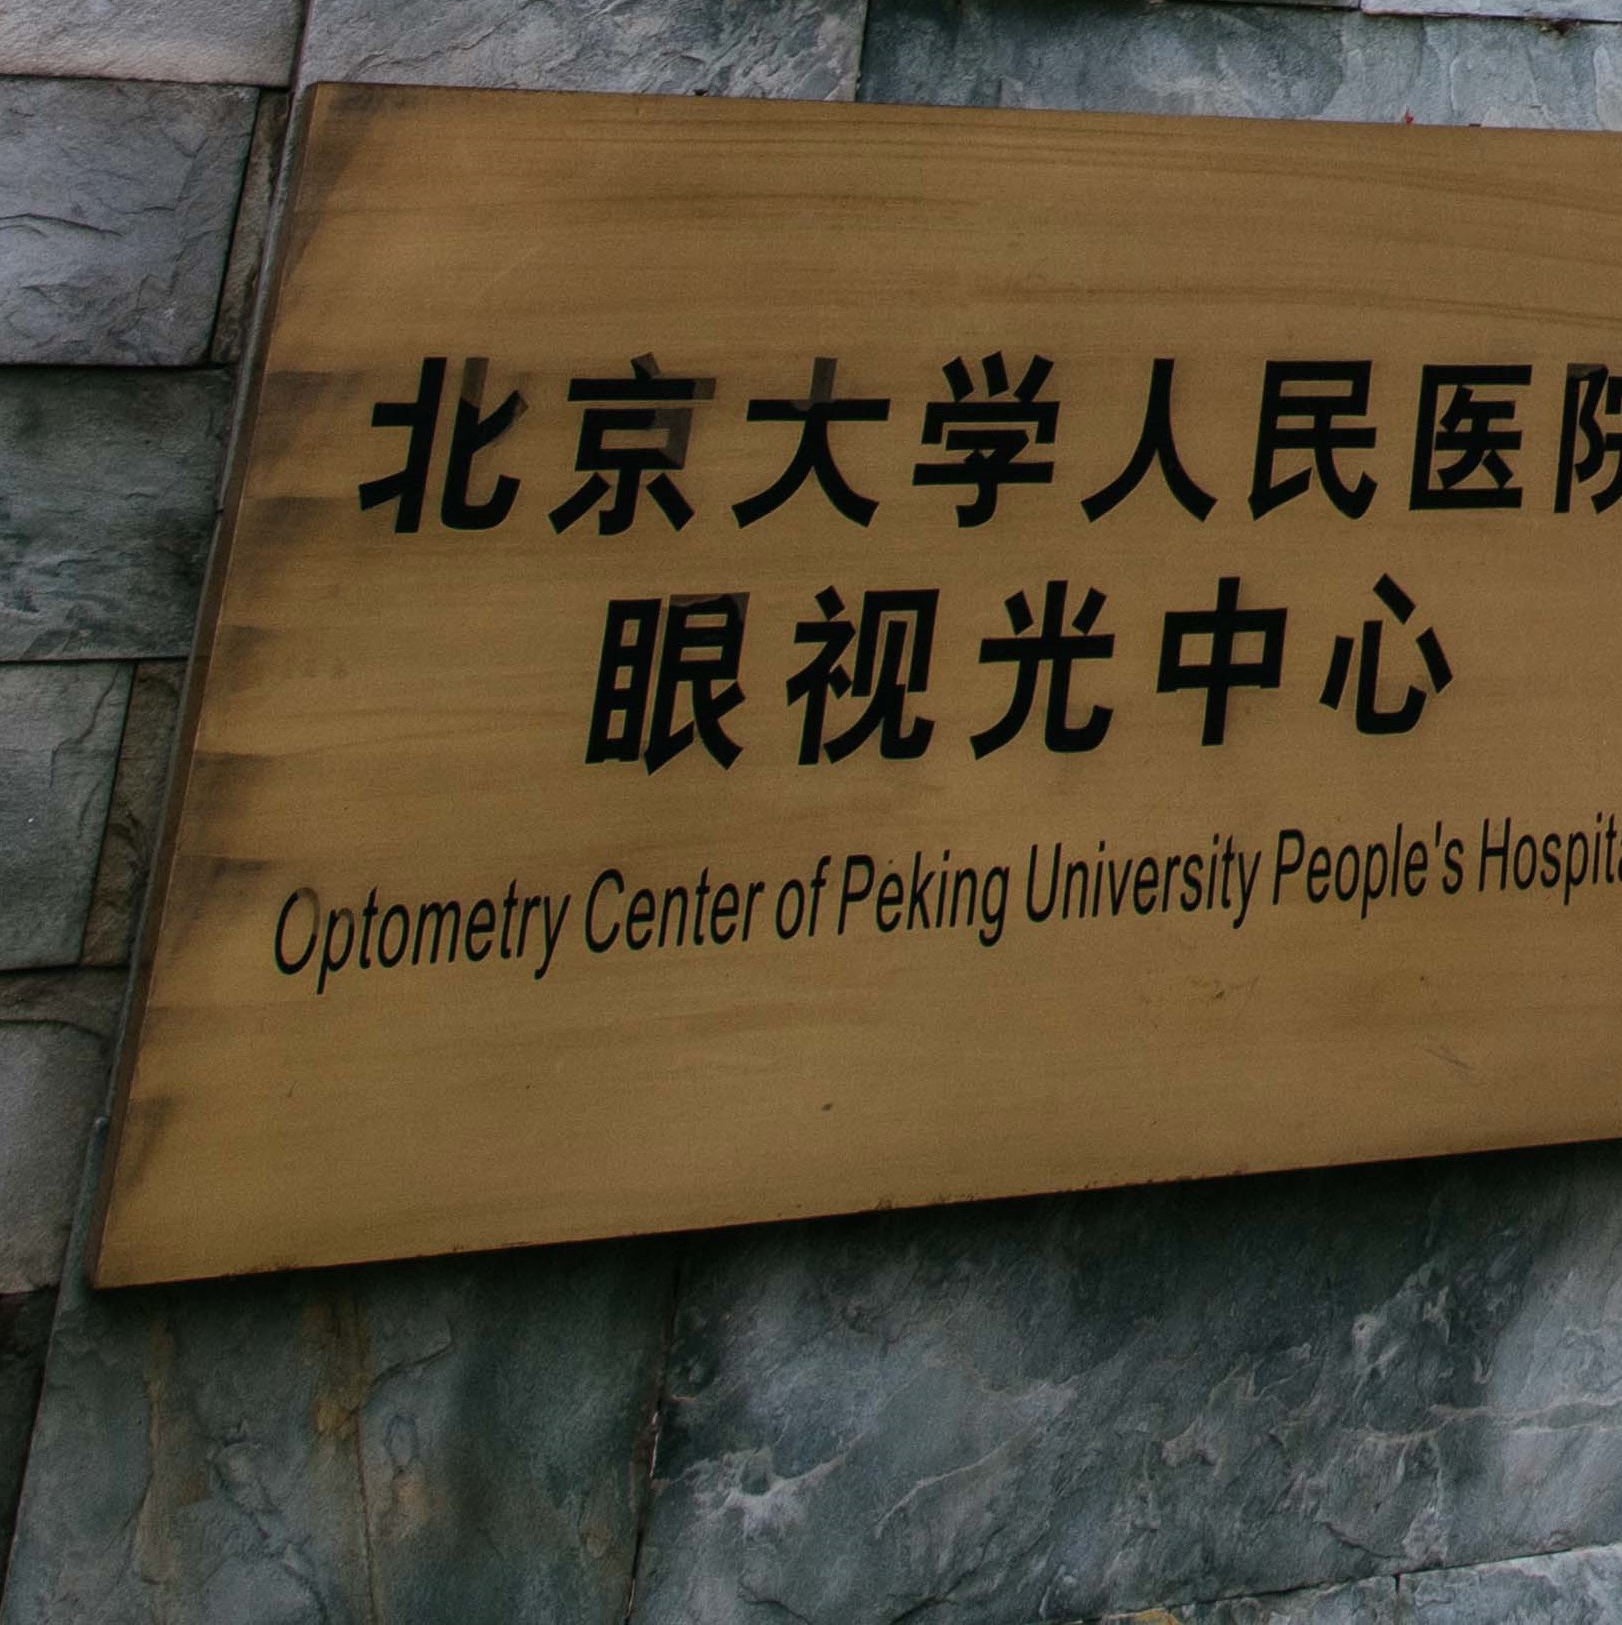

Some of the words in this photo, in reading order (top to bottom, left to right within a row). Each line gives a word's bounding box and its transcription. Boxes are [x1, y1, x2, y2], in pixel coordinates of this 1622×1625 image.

[584, 574, 1453, 775] 眼视光中心
[273, 877, 572, 995] Optometry
[584, 867, 765, 955] Center
[775, 855, 832, 942] of
[838, 849, 1011, 948] Peking
[1025, 833, 1262, 930] University
[1272, 820, 1465, 920] People's
